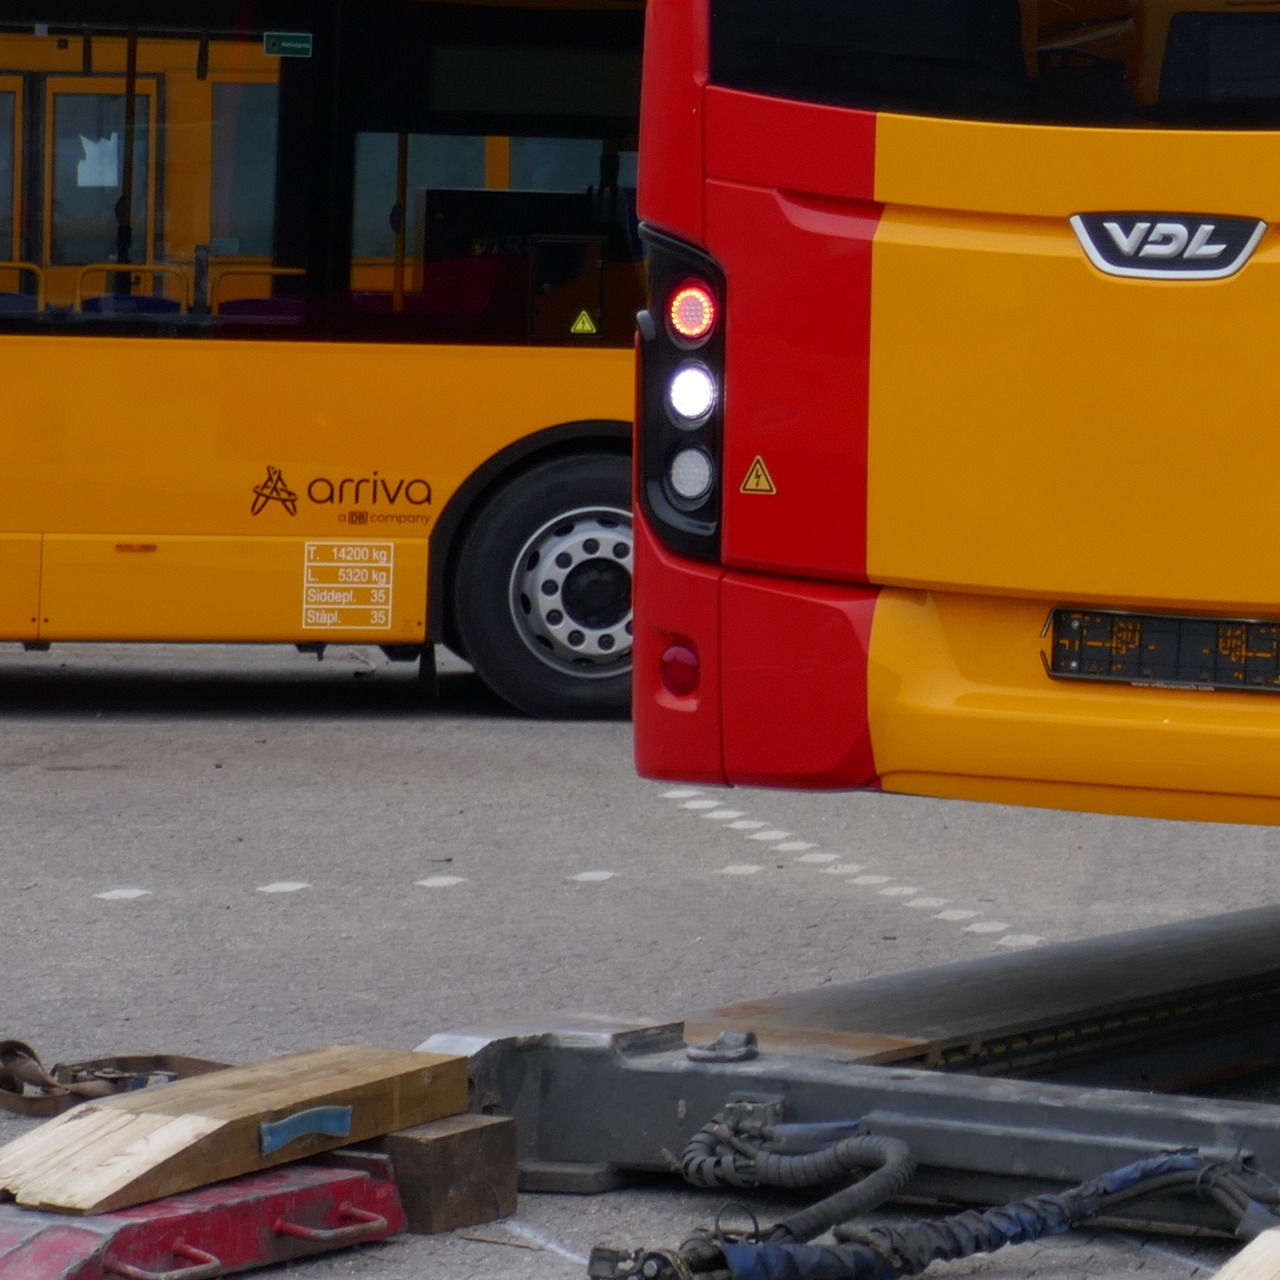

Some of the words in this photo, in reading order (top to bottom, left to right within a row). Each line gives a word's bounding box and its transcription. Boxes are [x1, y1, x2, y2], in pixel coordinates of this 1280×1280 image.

[1102, 222, 1228, 259] VDL
[306, 470, 433, 506] arriva
[337, 513, 346, 523] a
[349, 511, 368, 525] DB
[369, 513, 433, 526] company
[307, 546, 320, 561] T.
[331, 546, 369, 561] 14200
[372, 546, 388, 564] kg
[307, 568, 319, 583] L.
[337, 568, 369, 583] 5320
[371, 568, 387, 586] kg
[306, 587, 357, 605] Siddepl.
[370, 589, 386, 604] 35
[306, 609, 342, 627] Ståpl.
[370, 609, 386, 625] 35
